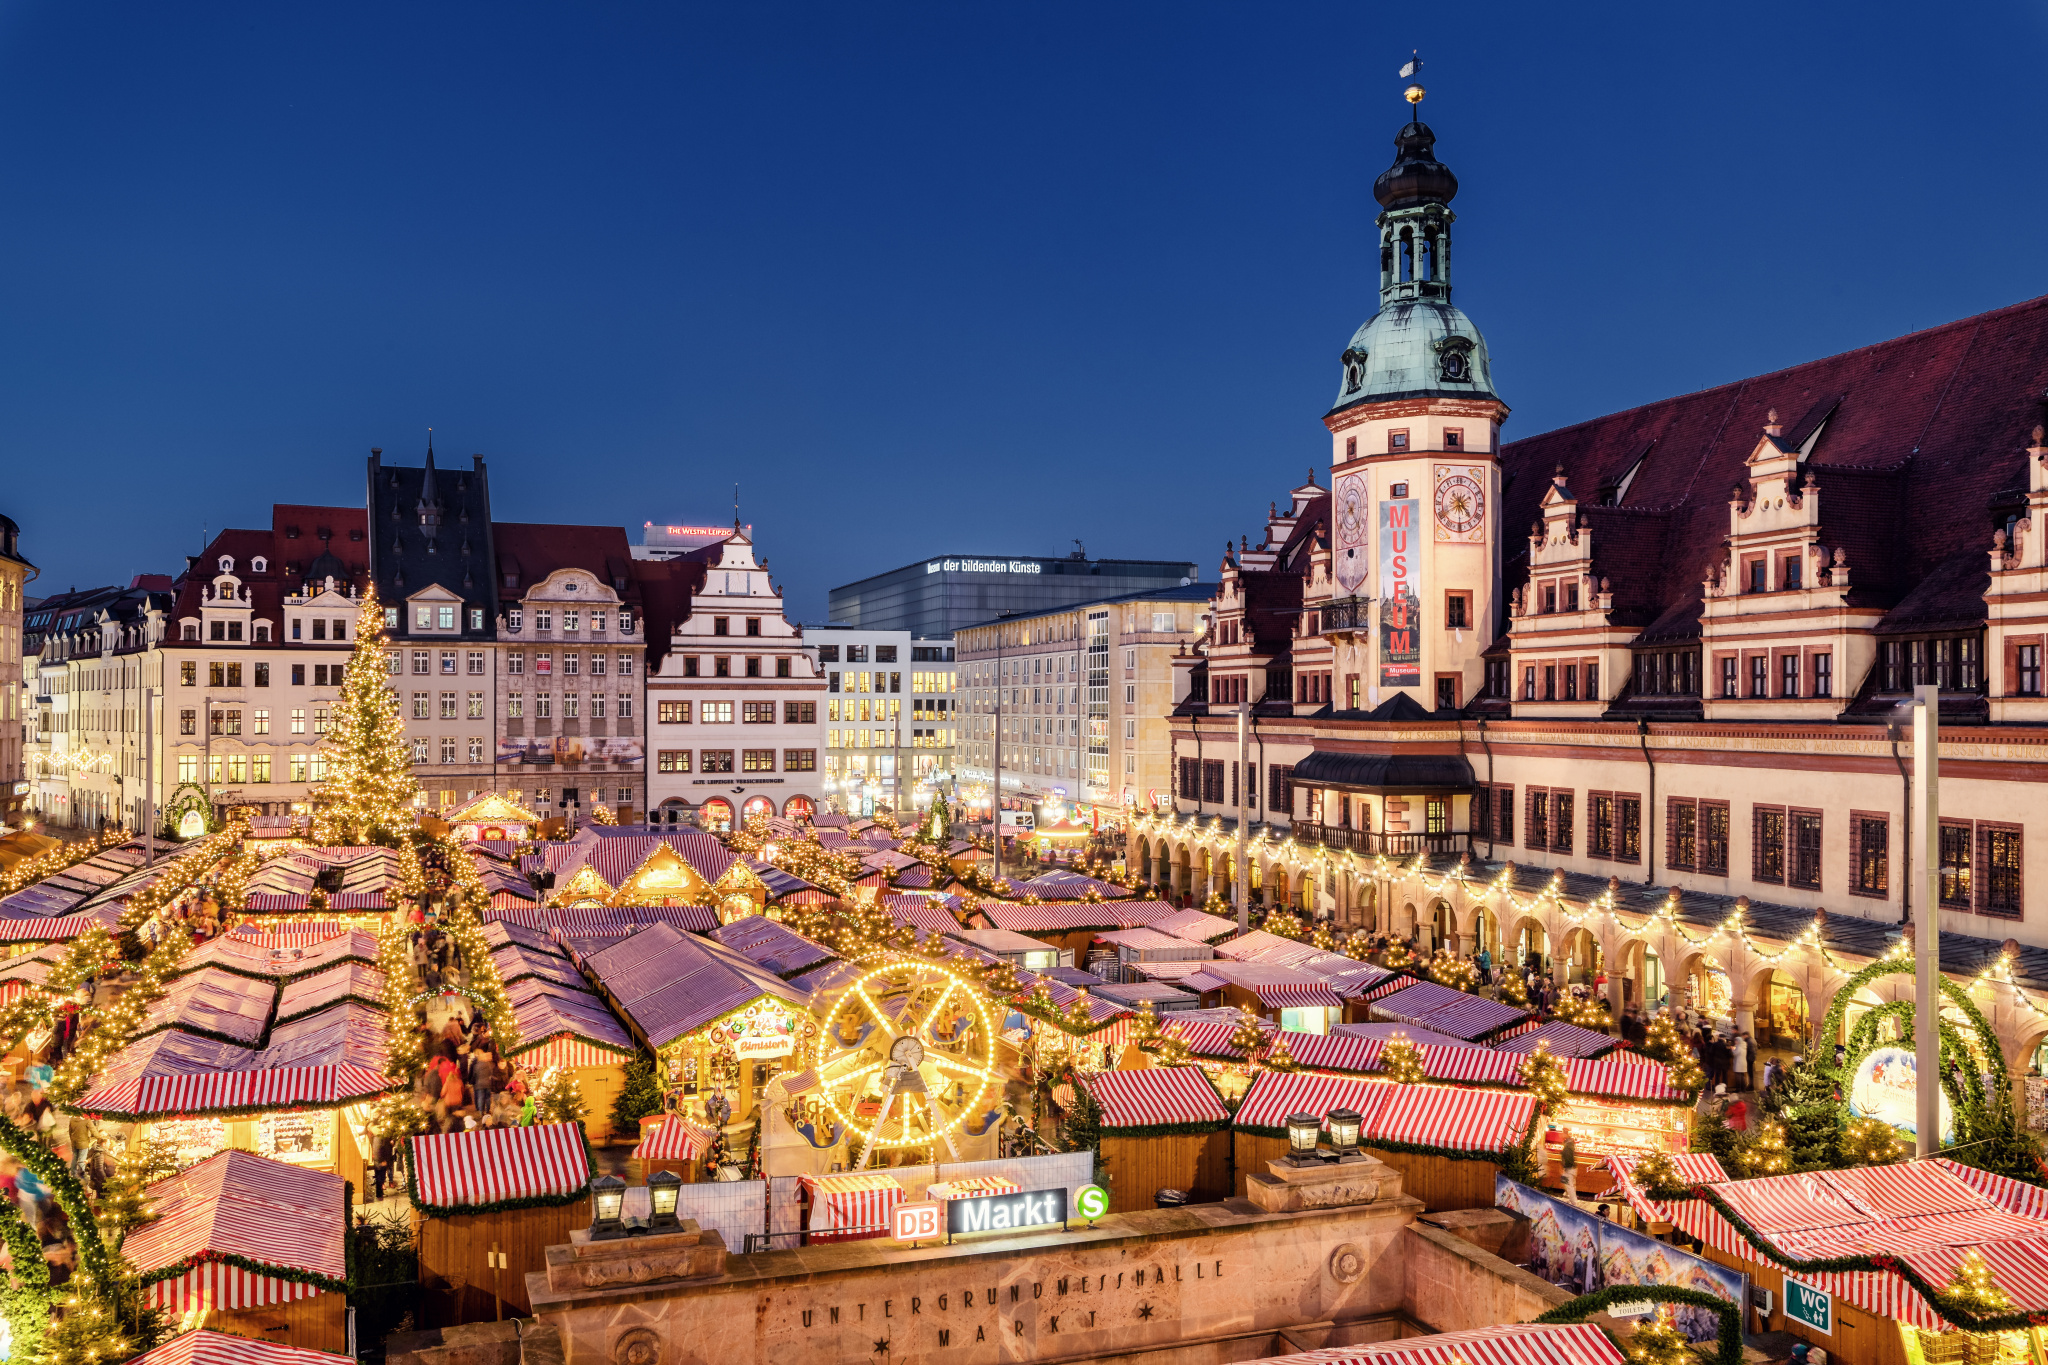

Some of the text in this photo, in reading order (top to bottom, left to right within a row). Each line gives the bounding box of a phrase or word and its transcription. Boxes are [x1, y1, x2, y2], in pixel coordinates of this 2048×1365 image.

[668, 527, 732, 536] THE WESTIN LEIPZIG
[943, 560, 960, 571] der
[962, 560, 1007, 573] bildenden
[1009, 561, 1041, 574] Künste
[1389, 505, 1410, 655] MUSEUM
[1594, 735, 1610, 745] UND
[1675, 736, 1727, 748] LANDGRAFF
[1734, 739, 1744, 749] IN
[1938, 744, 1985, 757] EISSEN
[900, 1190, 1104, 1237] DB Markt S
[1619, 1306, 1645, 1315] TOILETS
[1800, 1287, 1826, 1313] WC
[938, 1310, 1097, 1348] MARKT
